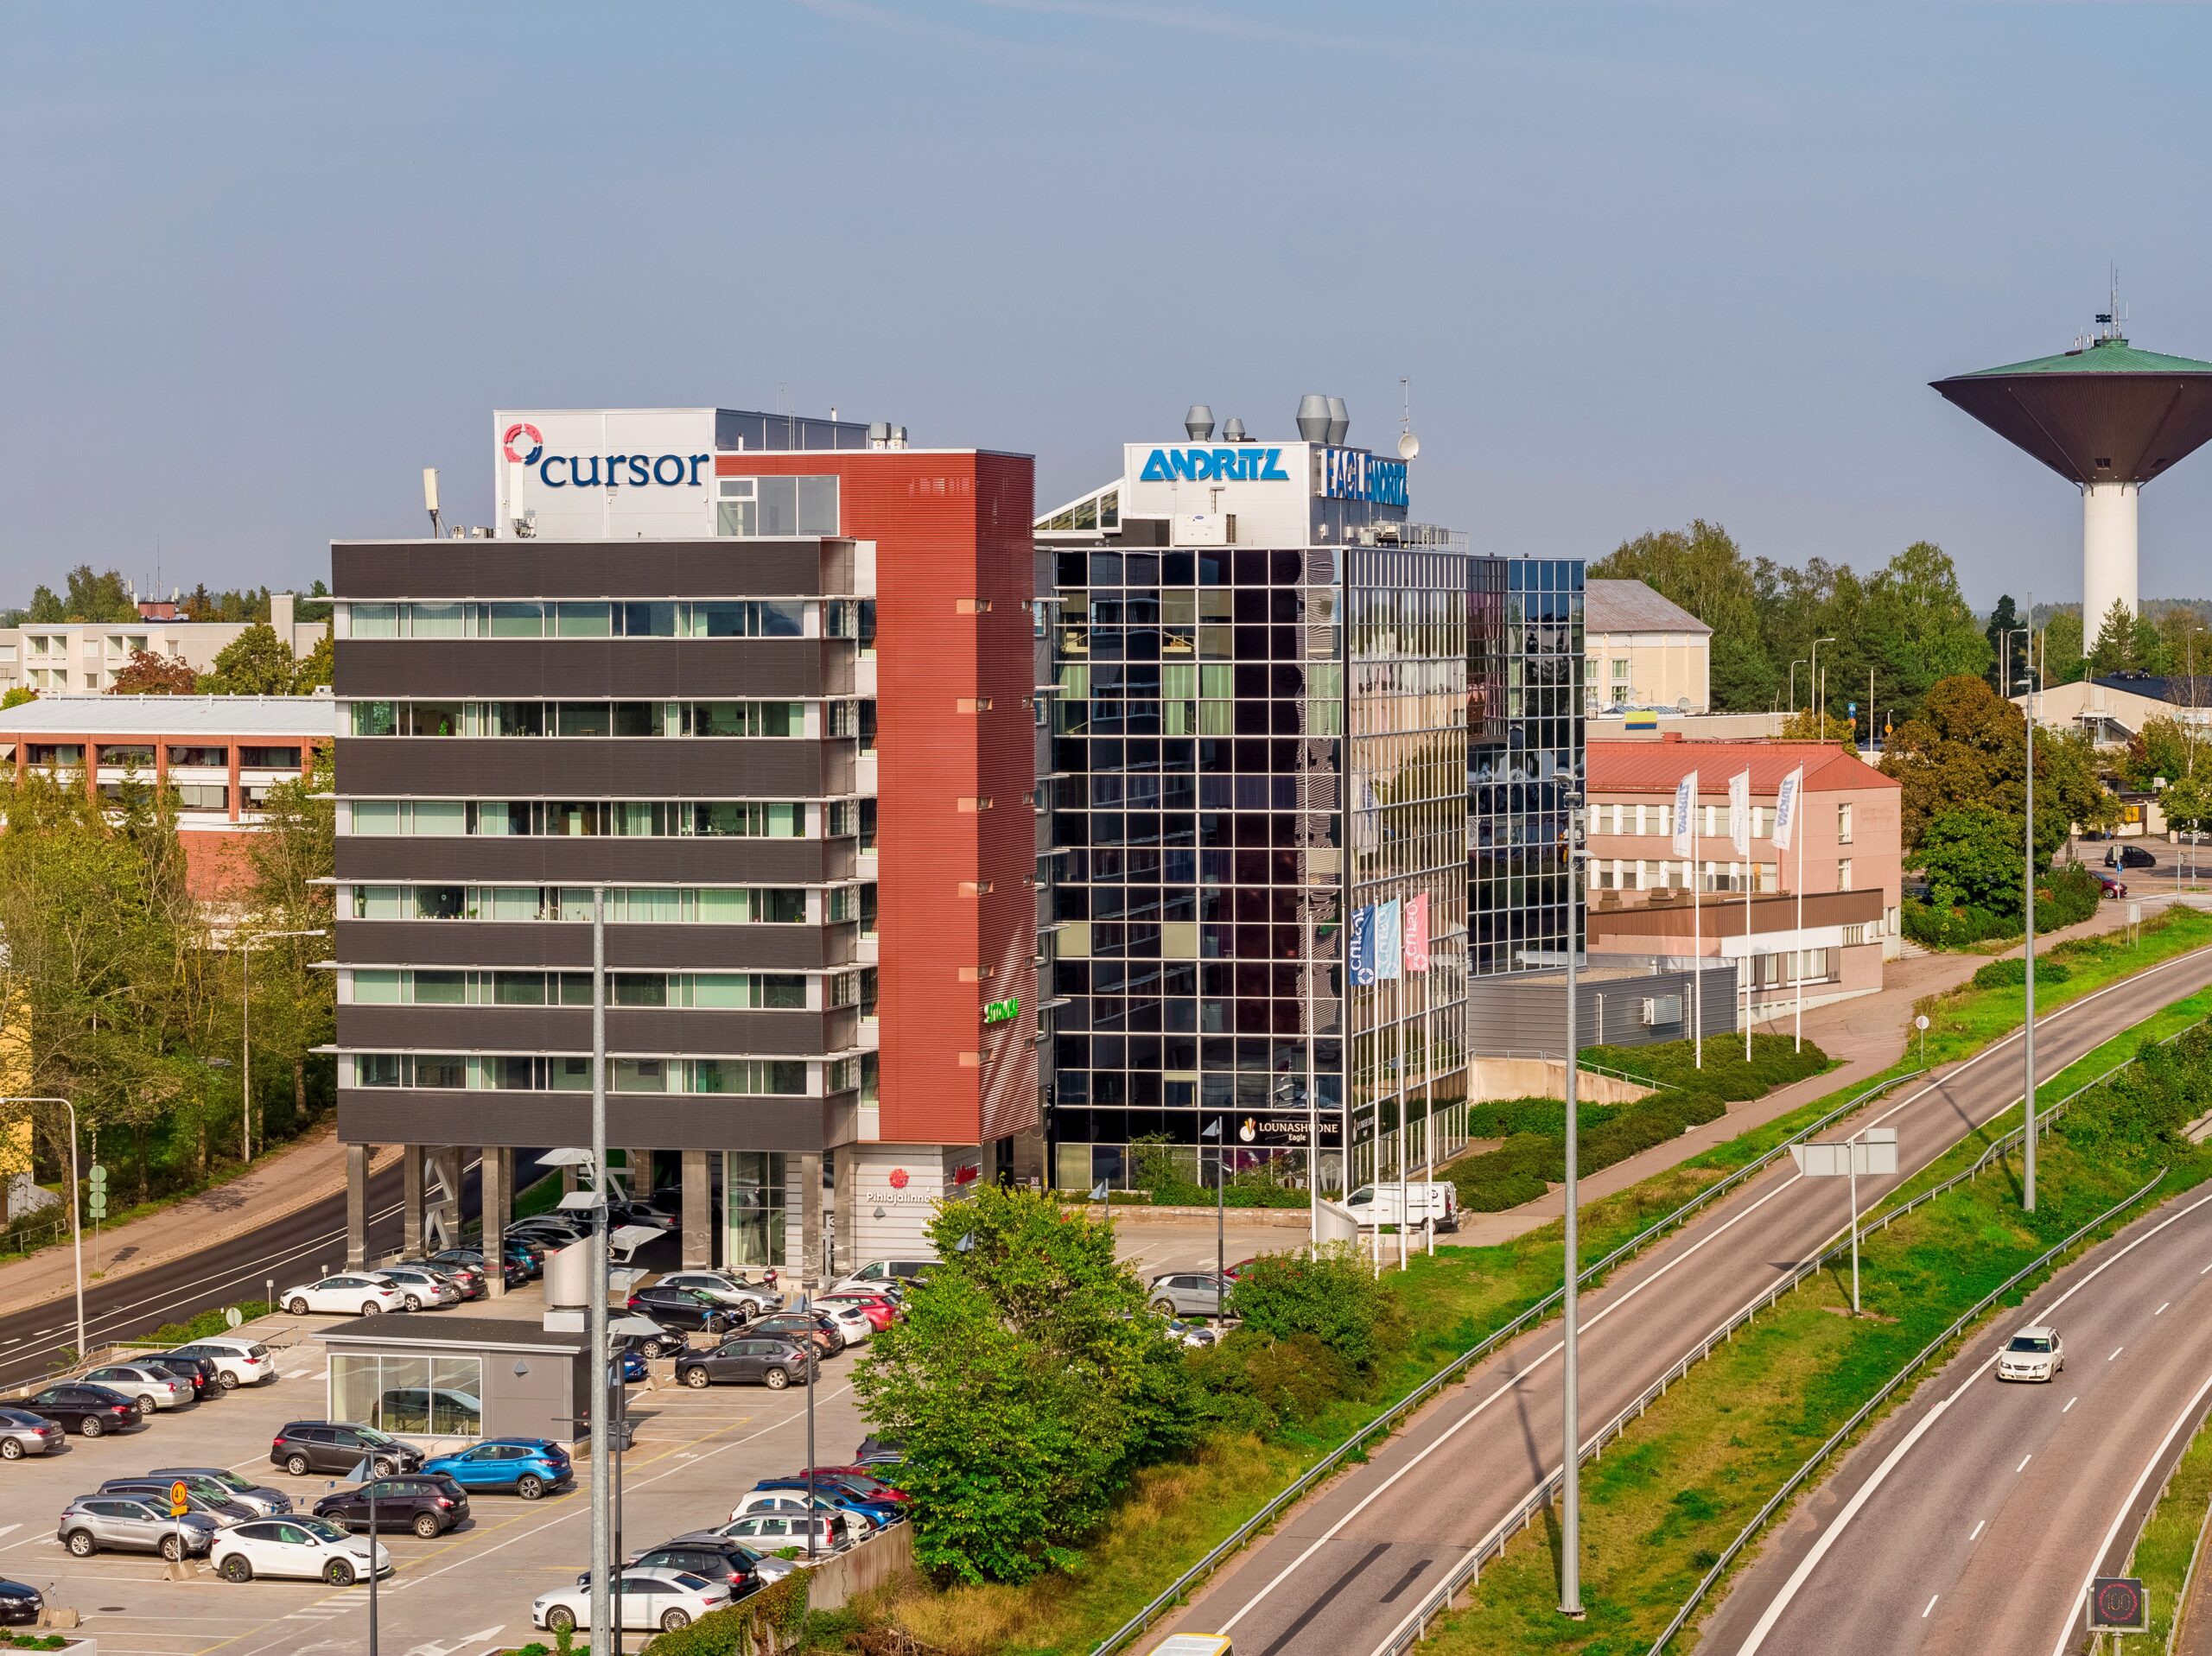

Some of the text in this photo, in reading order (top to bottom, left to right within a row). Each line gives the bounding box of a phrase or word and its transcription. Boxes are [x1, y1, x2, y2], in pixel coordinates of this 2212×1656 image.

[539, 454, 709, 487] cursor
[1140, 448, 1290, 481] ANDRITZ
[1322, 448, 1372, 500] EAGLE
[1370, 460, 1409, 506] NDRITZ
[1288, 1133, 1306, 1142] Eagle
[866, 1191, 931, 1207] Pihlajalinna
